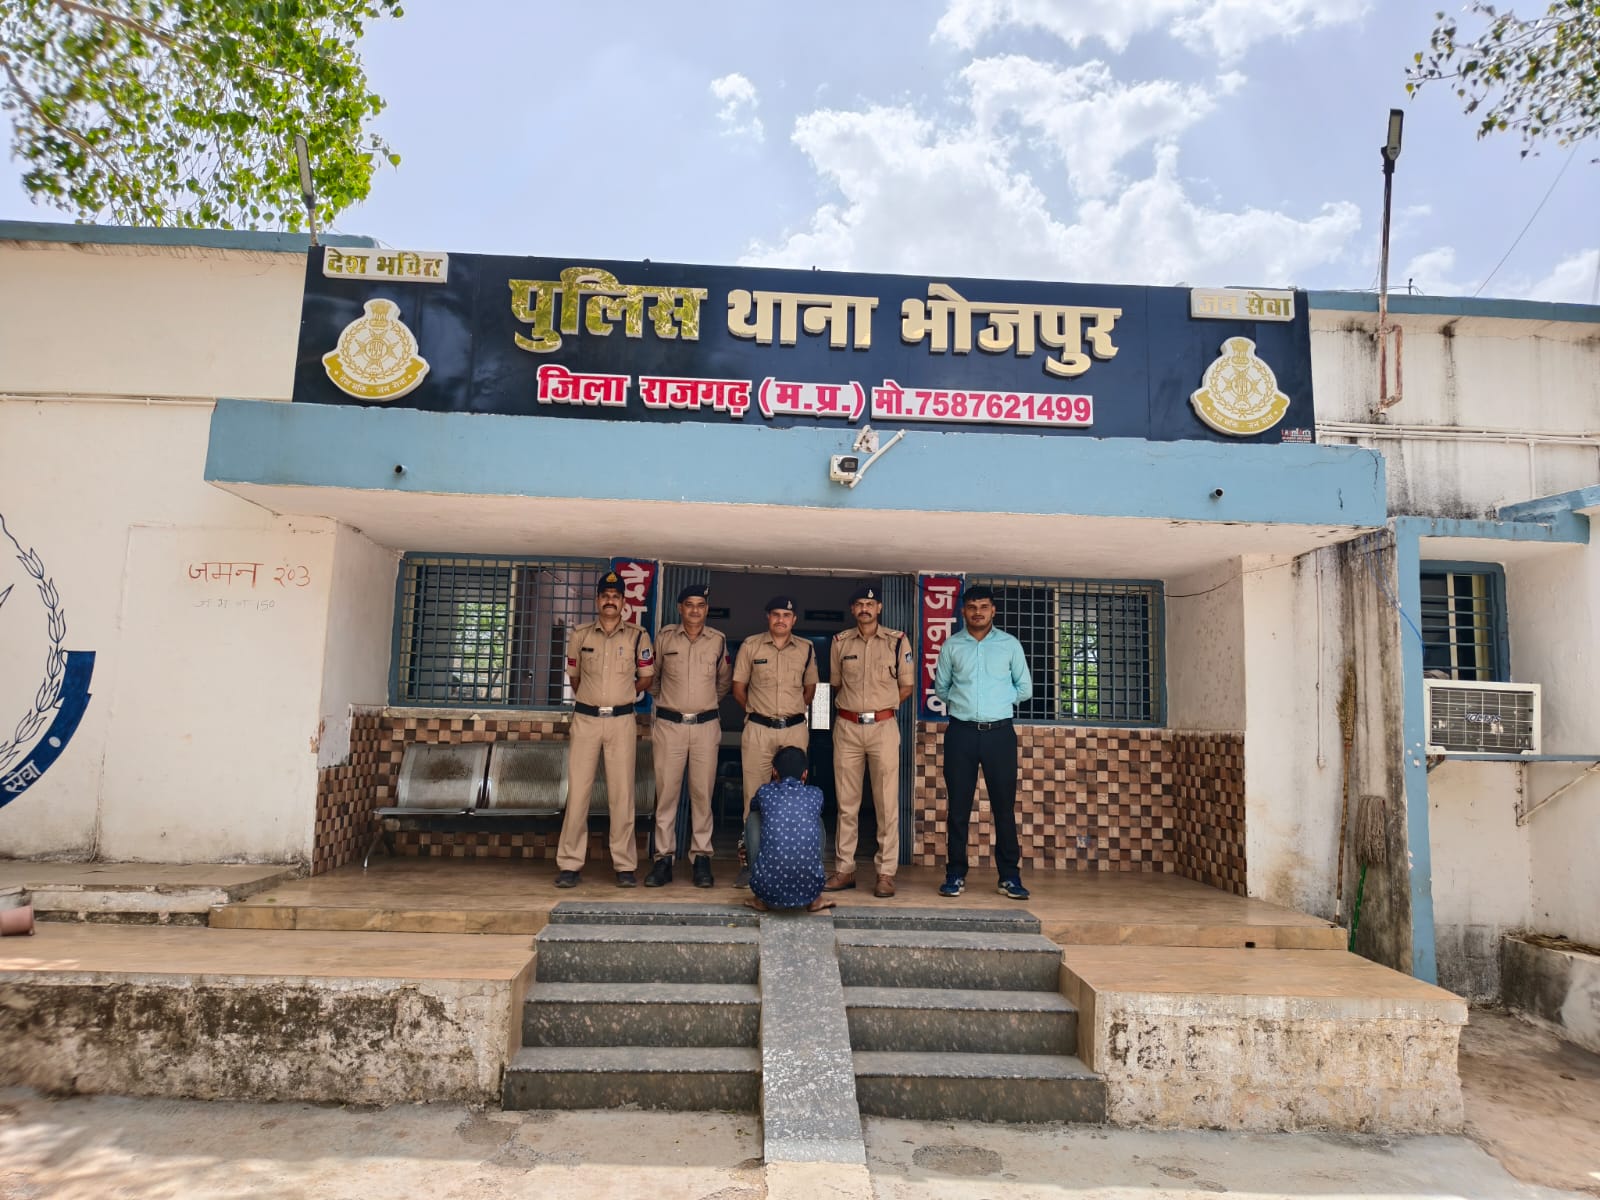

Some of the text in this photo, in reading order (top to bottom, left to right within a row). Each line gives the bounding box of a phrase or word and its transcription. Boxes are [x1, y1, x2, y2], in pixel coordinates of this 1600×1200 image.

[327, 247, 370, 274] देश
[508, 266, 1122, 377] पुलिस थाना भोजपुर
[537, 364, 631, 407] जिला
[639, 376, 752, 417] राजगढ़
[759, 377, 866, 421] (म.प्र.)
[2, 759, 42, 793] सेवा
